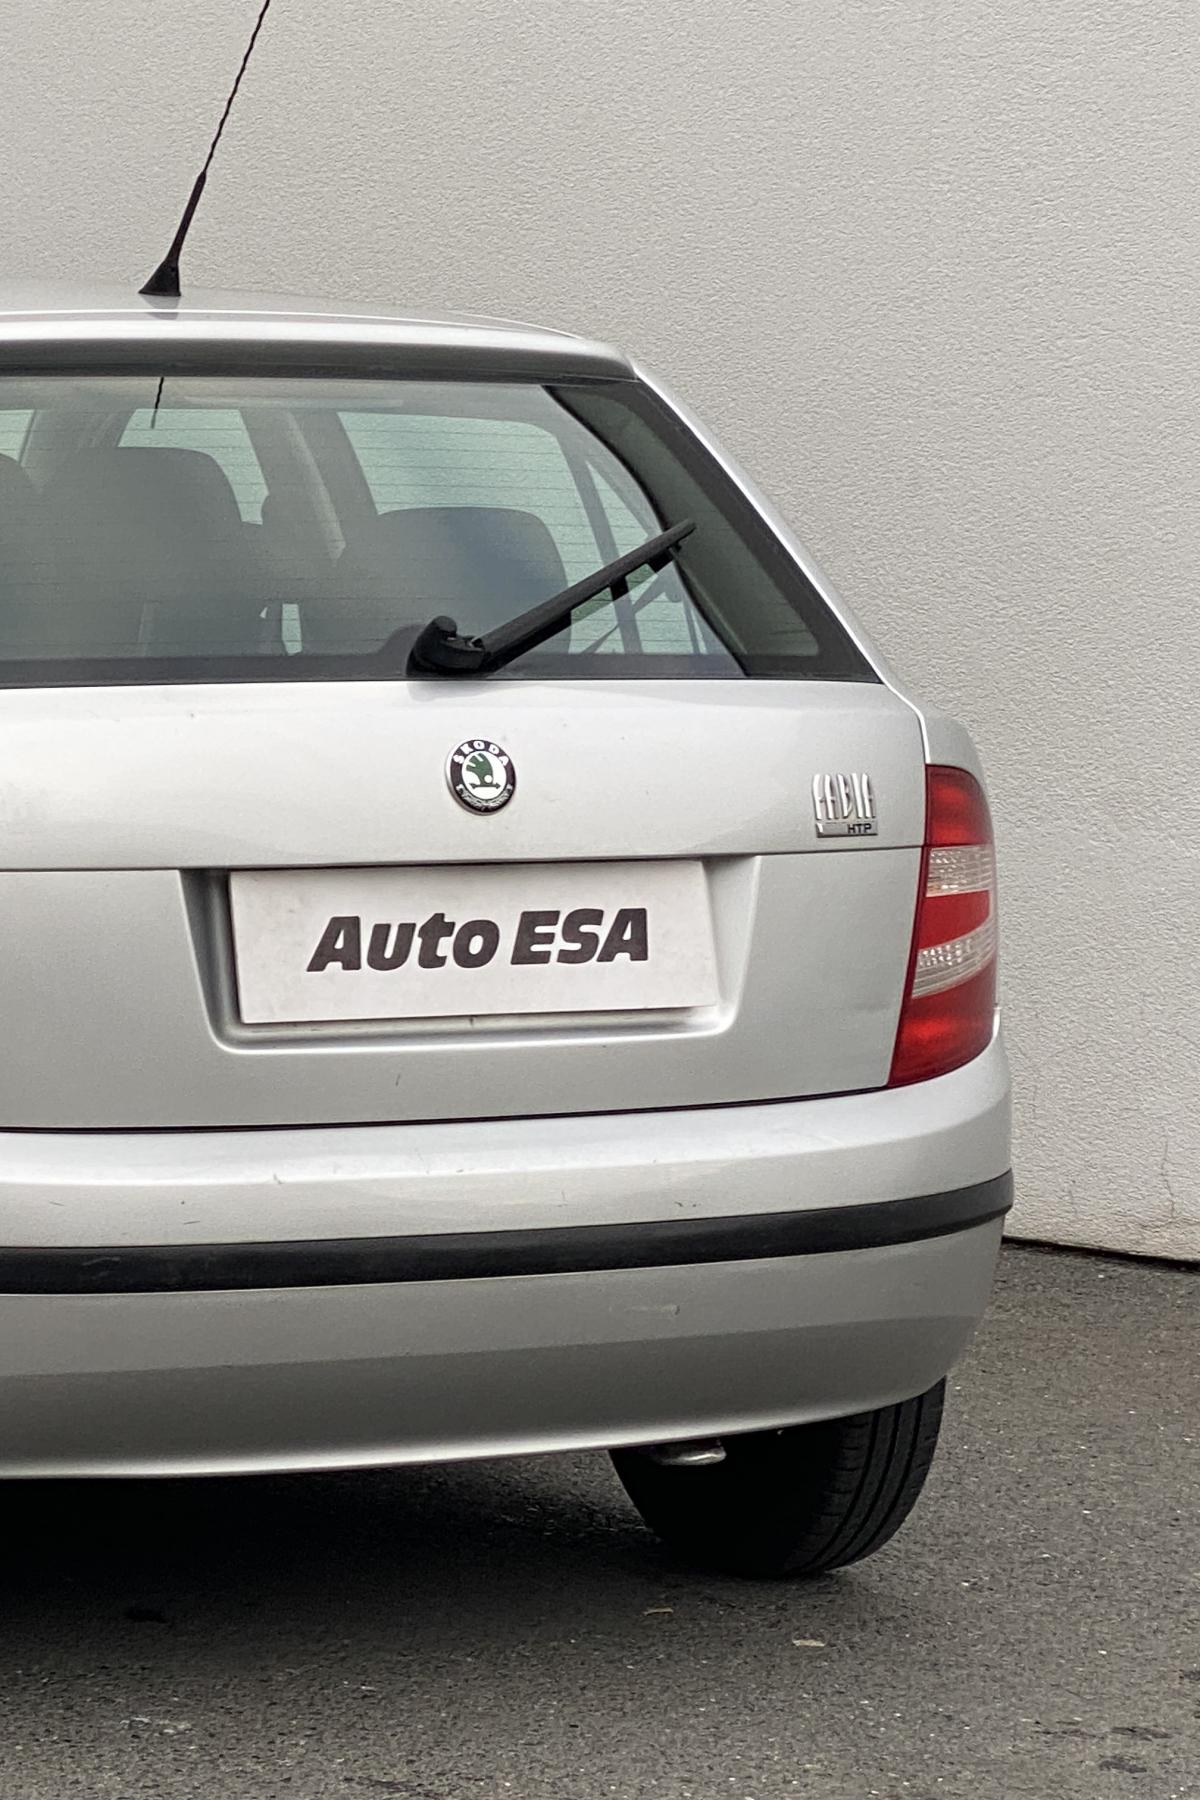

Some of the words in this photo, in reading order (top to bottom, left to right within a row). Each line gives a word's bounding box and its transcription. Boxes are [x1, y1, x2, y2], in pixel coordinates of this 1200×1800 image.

[847, 823, 872, 834] HTP
[306, 912, 501, 972] Auto
[510, 907, 649, 966] ESA
